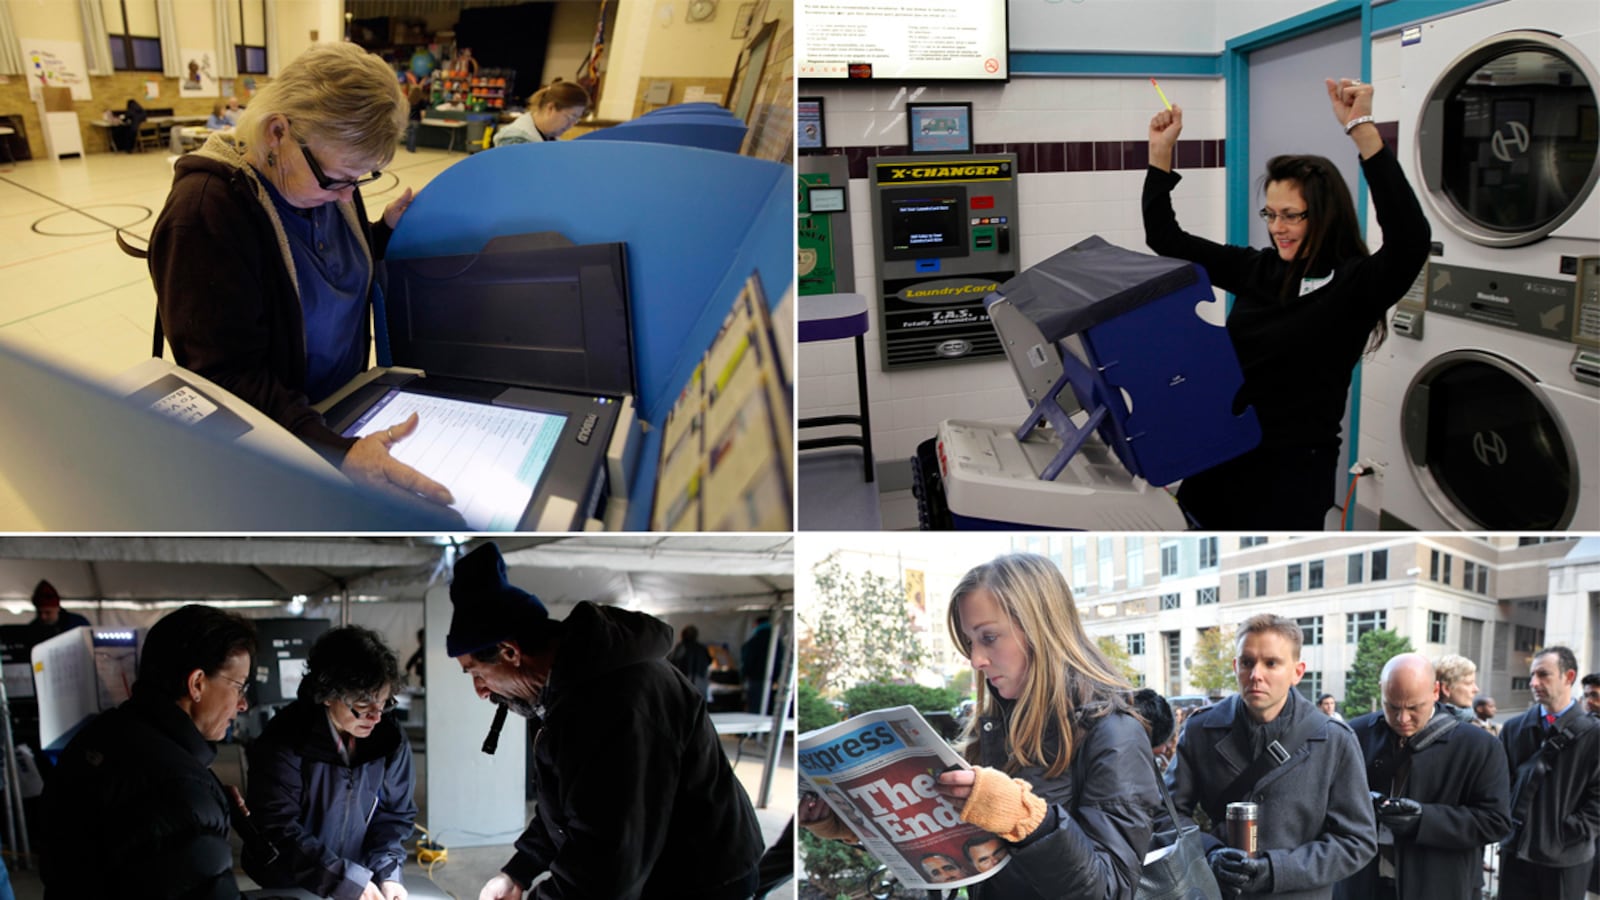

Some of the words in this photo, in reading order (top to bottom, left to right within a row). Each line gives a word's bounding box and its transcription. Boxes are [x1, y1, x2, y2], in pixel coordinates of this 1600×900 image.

[891, 166, 1000, 179] X-CHANGER
[905, 283, 997, 298] LaundryCard
[902, 320, 931, 328] Totally
[799, 726, 895, 772] express
[847, 772, 939, 817] The
[872, 795, 967, 843] End
